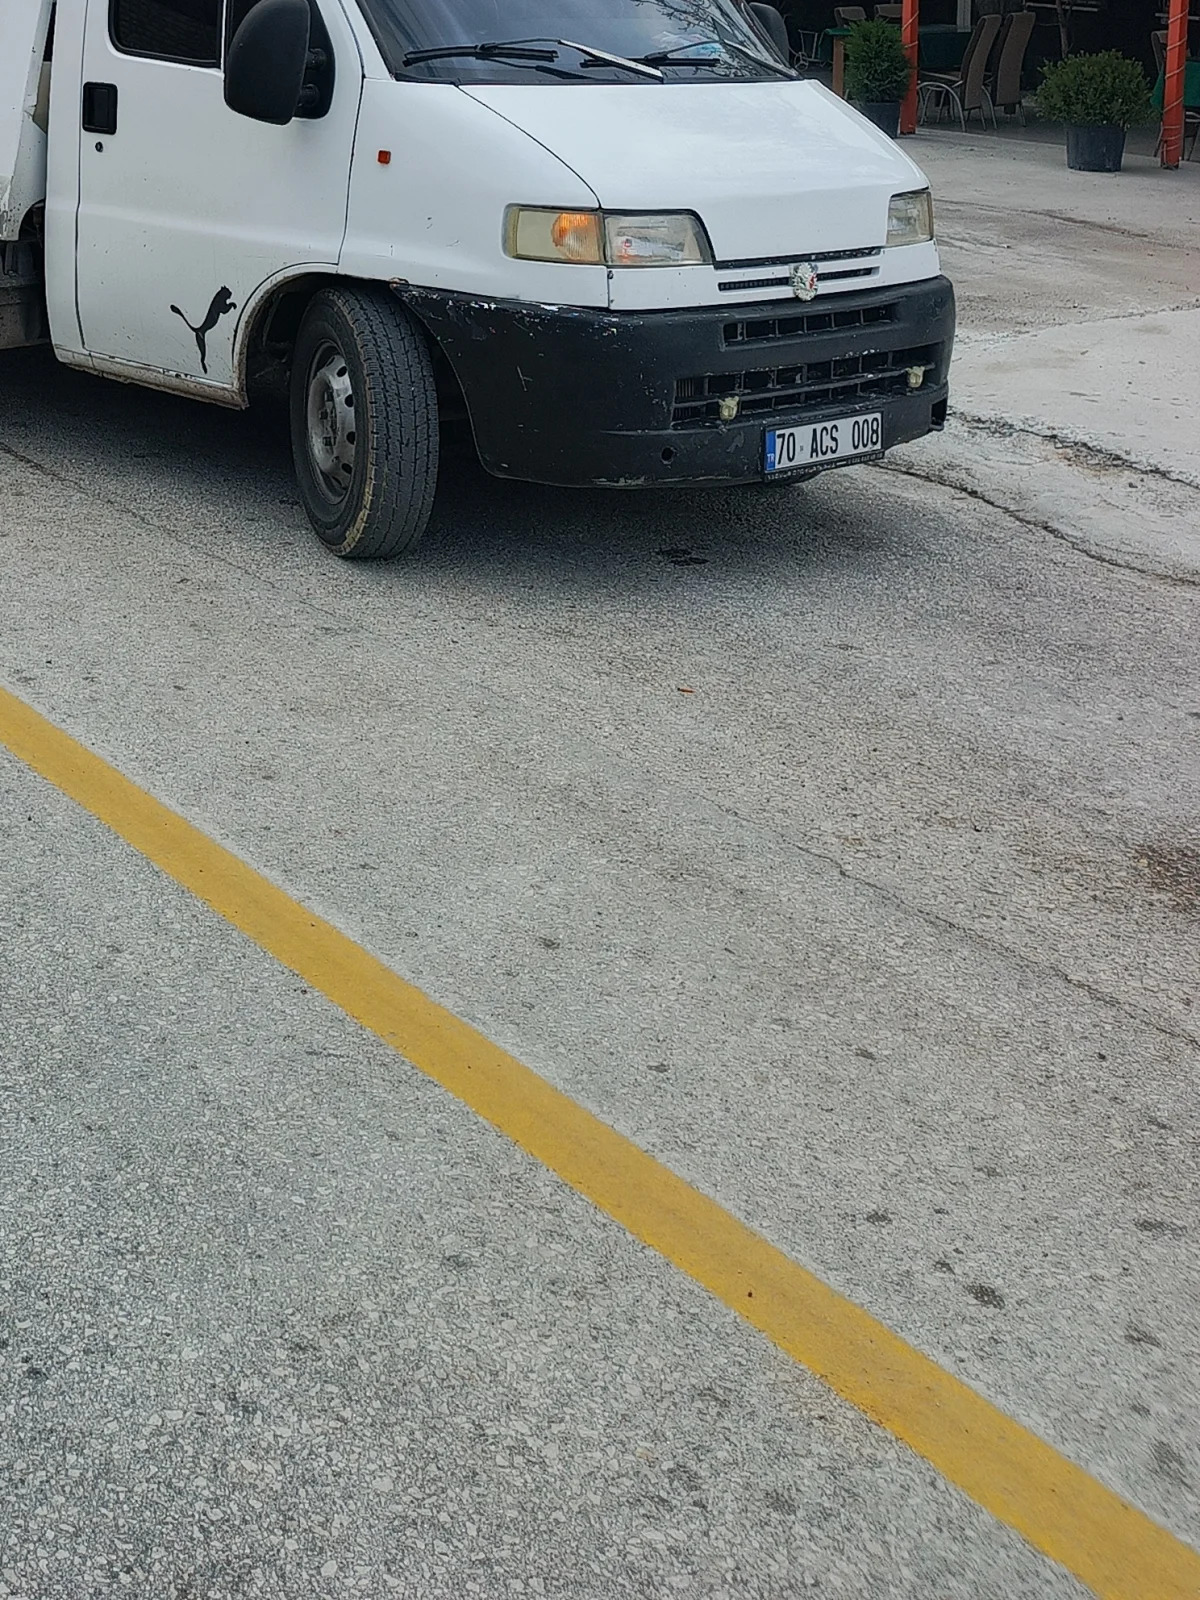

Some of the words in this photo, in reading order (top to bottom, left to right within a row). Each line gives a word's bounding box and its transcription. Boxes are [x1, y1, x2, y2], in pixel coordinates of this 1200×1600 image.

[776, 432, 796, 465] 70
[810, 424, 839, 459] ACS
[852, 417, 880, 450] 008
[766, 453, 775, 464] TR
